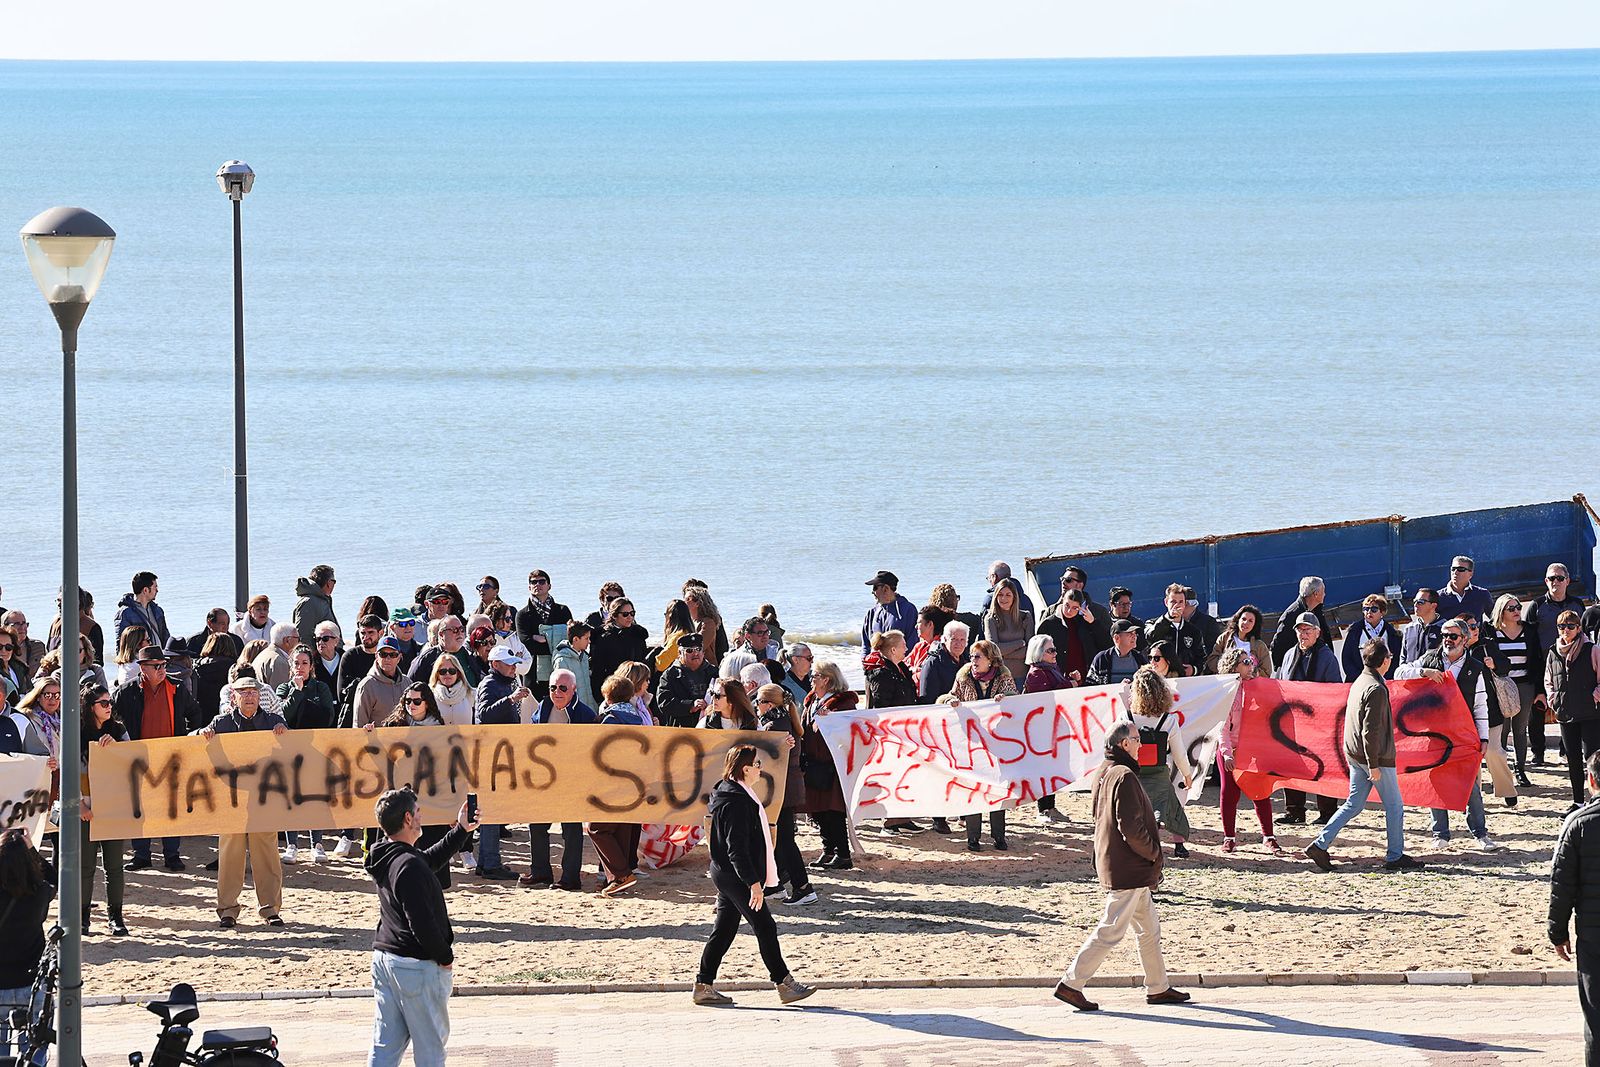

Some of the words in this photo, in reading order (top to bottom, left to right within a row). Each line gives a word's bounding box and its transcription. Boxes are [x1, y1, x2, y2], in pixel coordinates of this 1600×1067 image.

[128, 732, 558, 821] MATALASCAÑAS
[846, 691, 1185, 776] MATALASCAÑ
[1267, 690, 1453, 782] SS
[858, 763, 921, 807] SE
